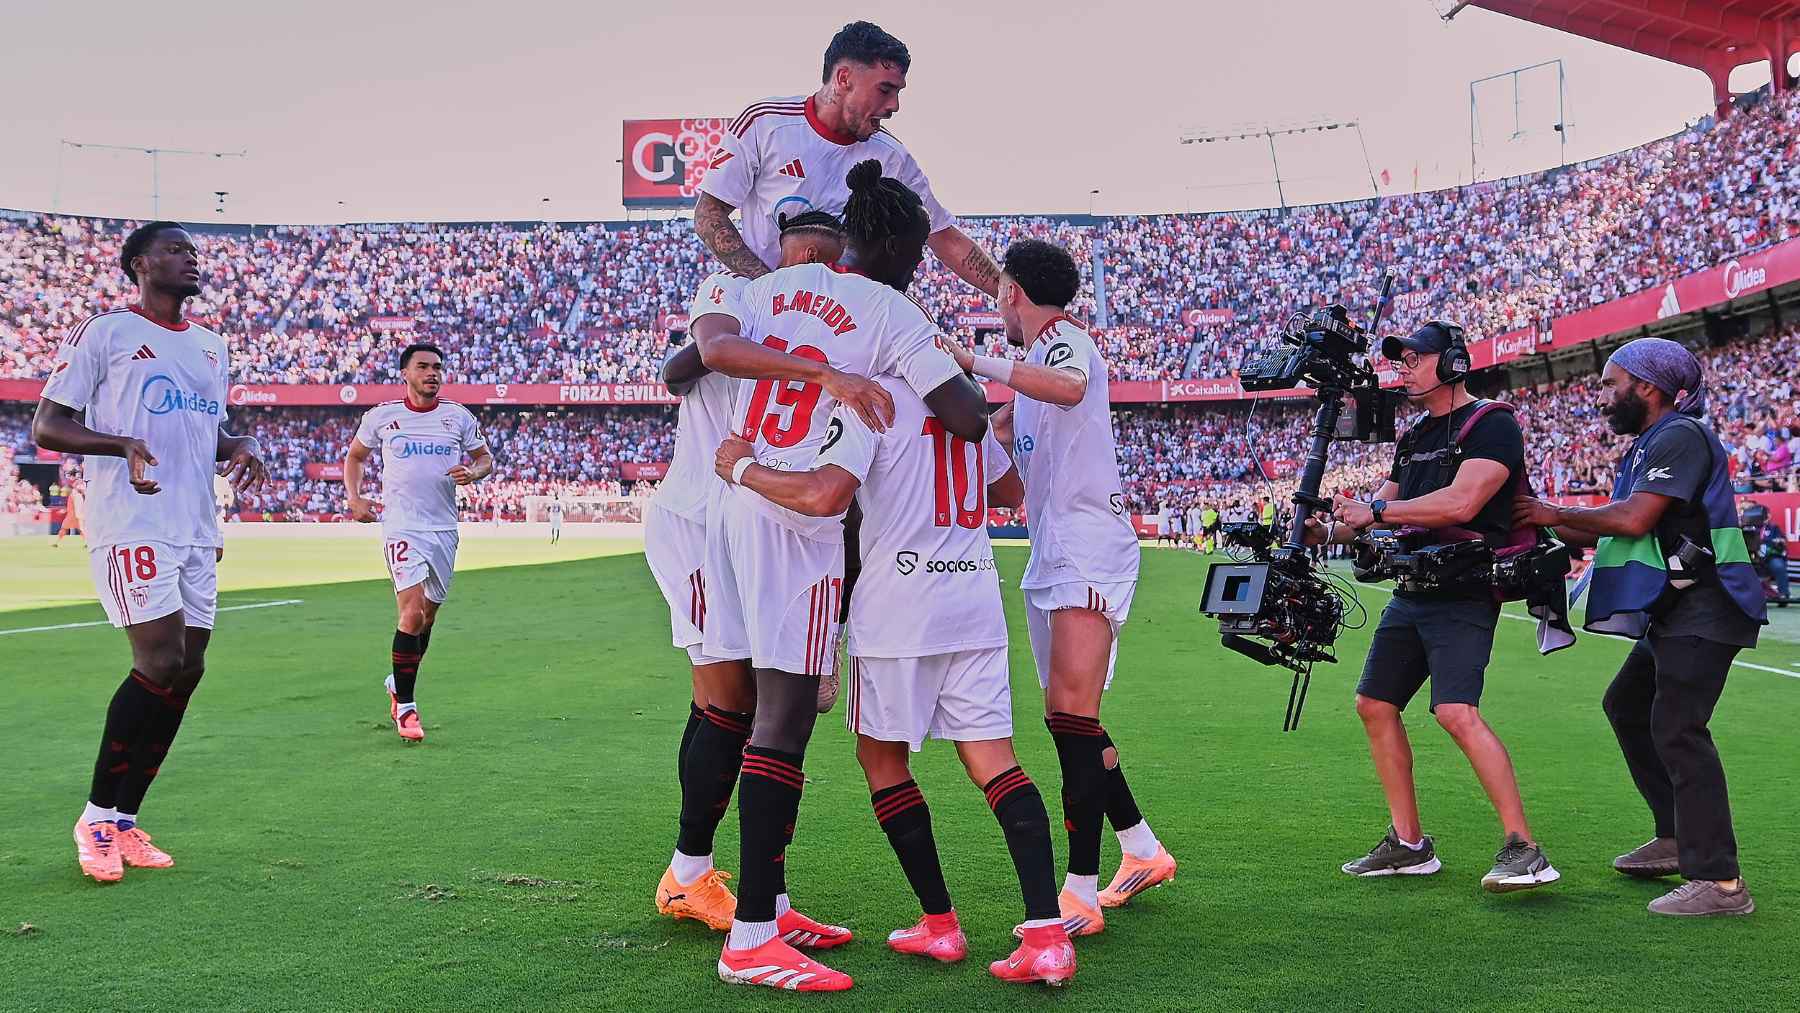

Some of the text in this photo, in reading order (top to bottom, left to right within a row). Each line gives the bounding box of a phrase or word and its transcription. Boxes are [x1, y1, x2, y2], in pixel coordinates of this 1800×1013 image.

[1724, 260, 1766, 298] Midea
[1189, 309, 1226, 326] Midea
[142, 375, 219, 415] Midea
[230, 385, 277, 405] Midea
[559, 386, 609, 401] FORZA
[742, 334, 829, 448] 19
[1185, 382, 1237, 397] CaixaBank
[390, 435, 452, 459] Midea
[921, 416, 986, 529] 10
[118, 545, 157, 584] 18
[389, 541, 409, 564] 12
